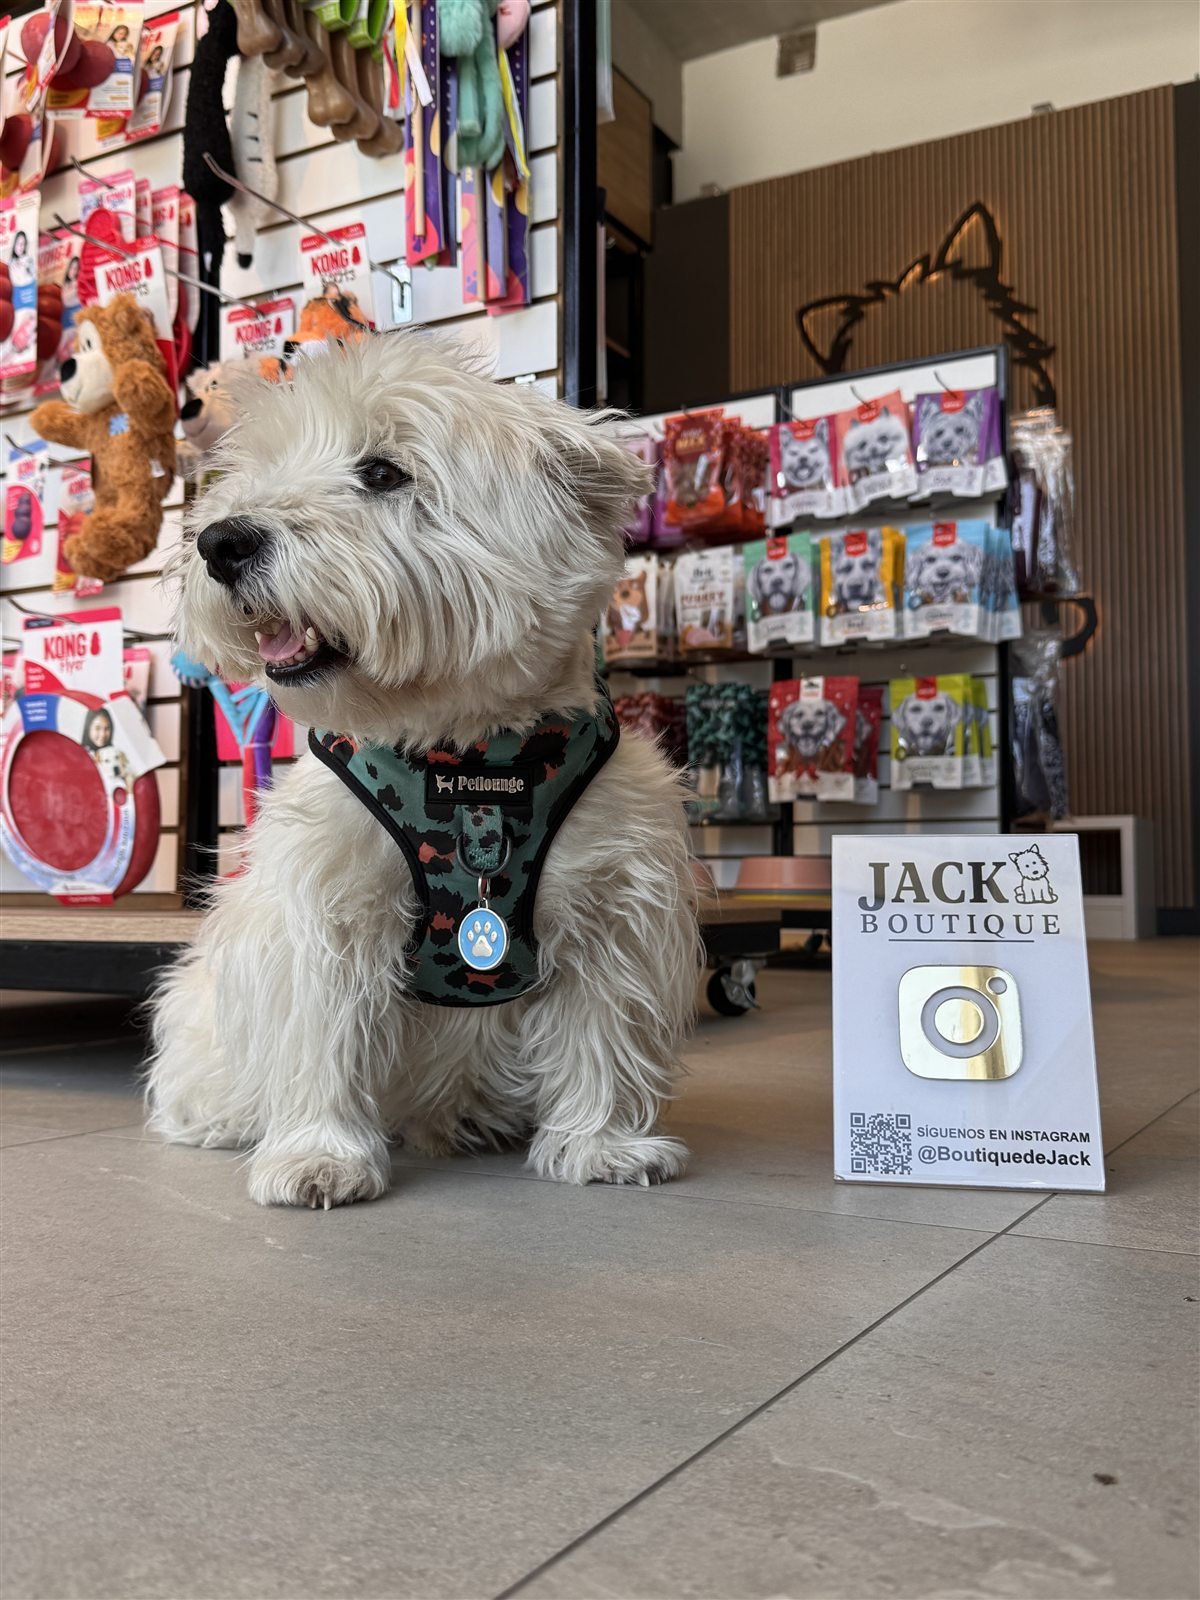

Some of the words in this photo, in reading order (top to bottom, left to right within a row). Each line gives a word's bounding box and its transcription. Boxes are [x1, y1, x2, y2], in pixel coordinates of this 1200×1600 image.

[310, 249, 349, 276] KONG
[105, 261, 142, 292] KONG
[235, 320, 272, 345] KONG
[44, 633, 86, 660] KONG
[458, 775, 524, 793] Petlounge
[858, 861, 1010, 911] JACK
[860, 913, 1061, 939] BOUTIQUE
[917, 1124, 985, 1140] SÍGUENOS
[989, 1129, 1007, 1141] EN
[1011, 1130, 1091, 1143] INSTAGRAM
[918, 1145, 1092, 1167] @BoutiquedeJack
